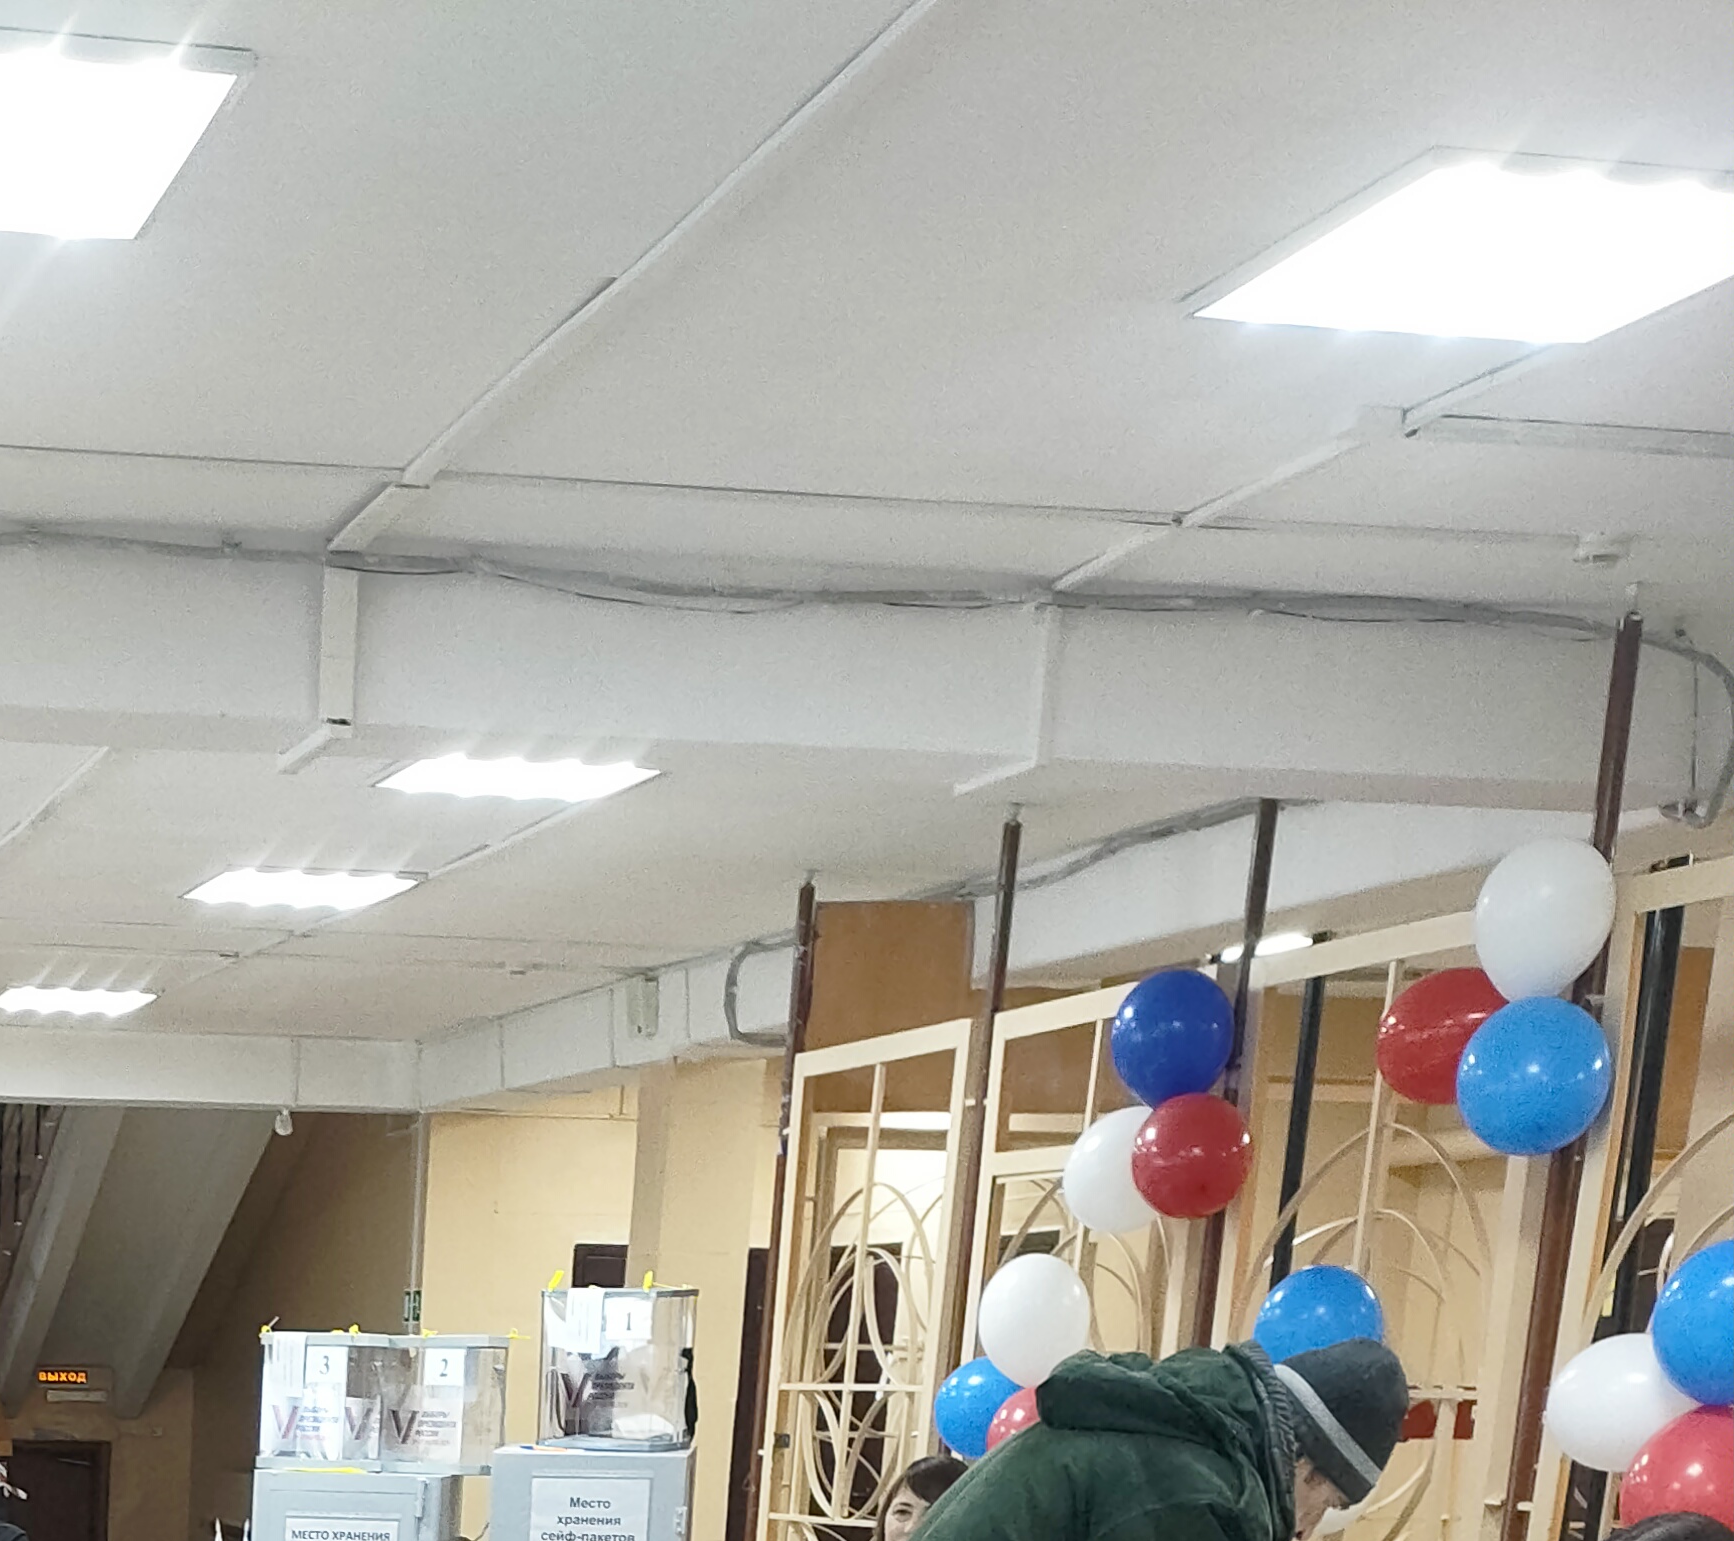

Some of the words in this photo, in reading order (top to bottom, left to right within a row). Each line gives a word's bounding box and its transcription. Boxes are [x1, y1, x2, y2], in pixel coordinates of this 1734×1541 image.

[319, 1355, 330, 1375] 3
[438, 1358, 449, 1377] 2
[38, 1372, 86, 1383] ВЫХОД
[569, 1496, 611, 1510] Место
[557, 1514, 621, 1528] хранения
[291, 1528, 330, 1541] МЕСТО
[332, 1529, 391, 1541] ХРАНЕНИЯ
